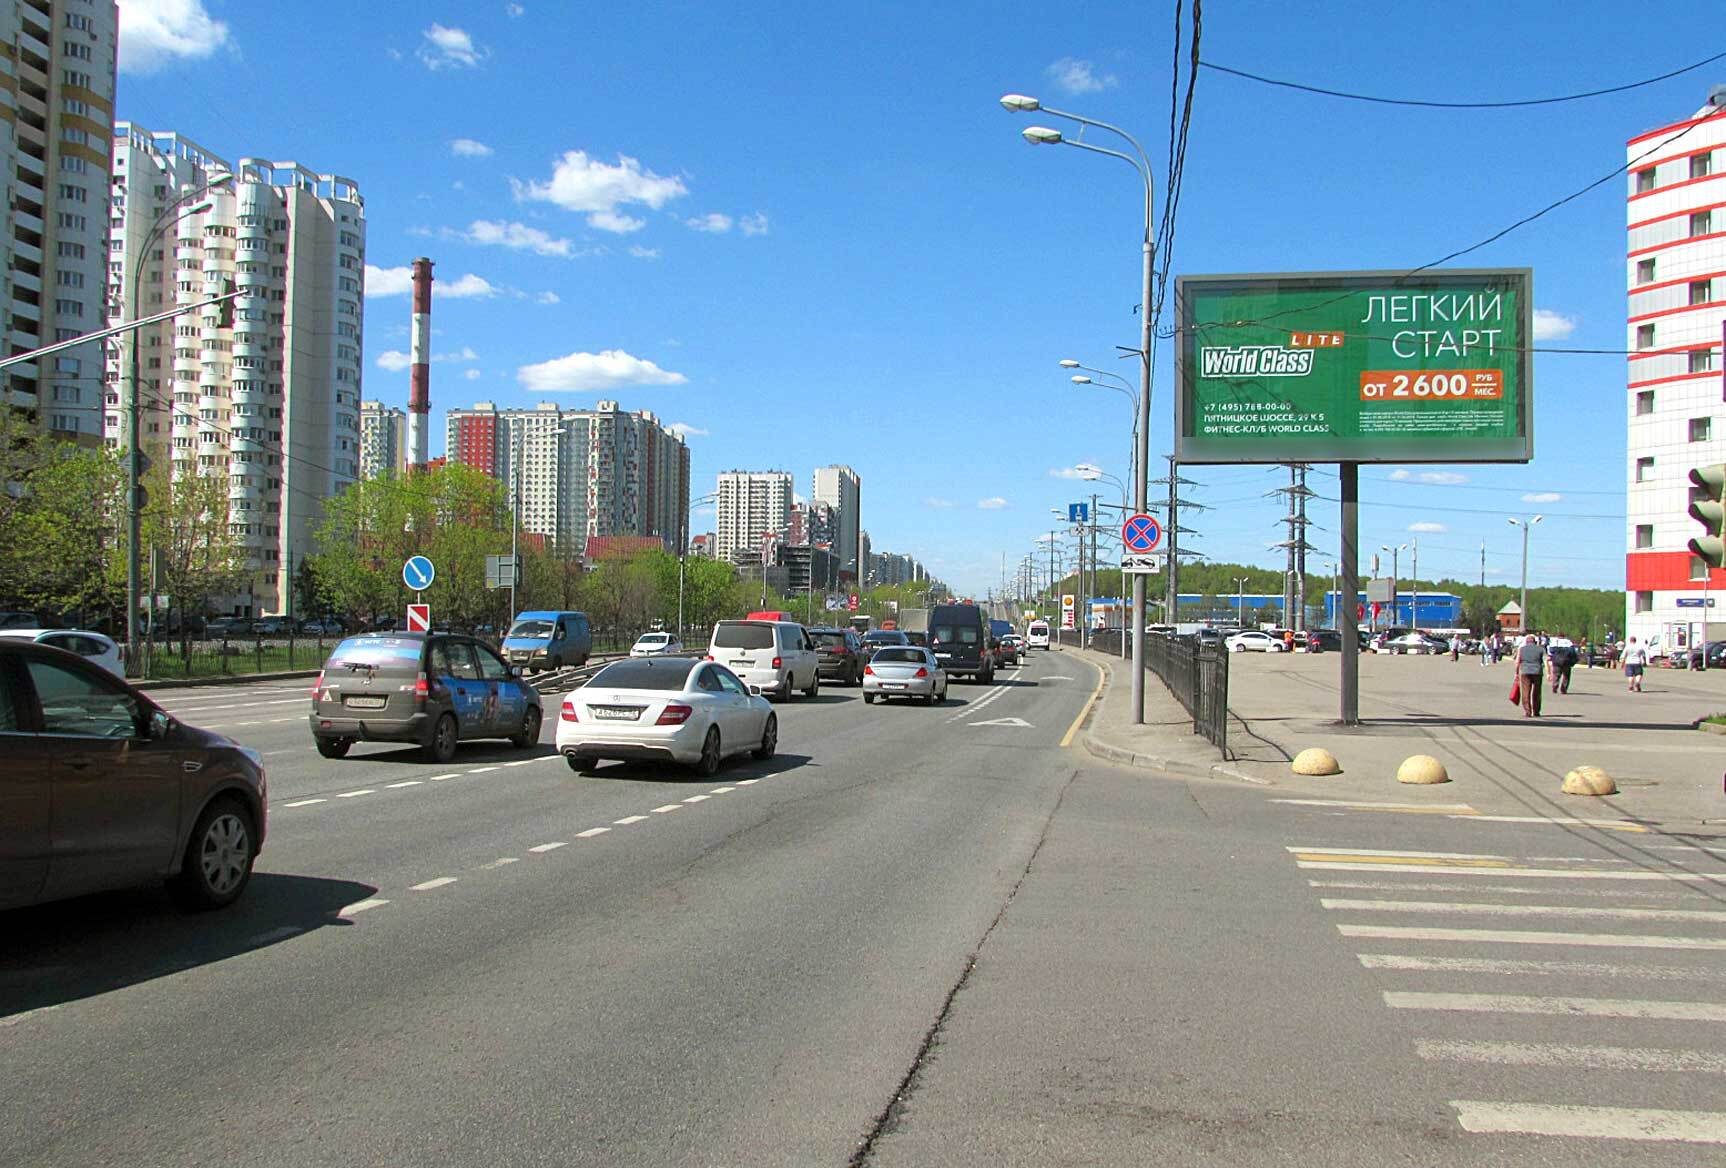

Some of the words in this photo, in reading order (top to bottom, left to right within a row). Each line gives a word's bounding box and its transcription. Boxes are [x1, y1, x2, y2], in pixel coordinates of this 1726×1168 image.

[1361, 288, 1501, 323] ЛЕГКИЙ
[1291, 334, 1341, 346] LITE
[1392, 330, 1502, 358] СТАРТ
[1204, 349, 1258, 374] World
[1259, 349, 1309, 373] Class
[1363, 383, 1387, 397] ОТ
[1218, 403, 1242, 412] (495)
[1204, 414, 1258, 423] ПЯТНИЦКОЕ
[1268, 424, 1301, 433] WORLD
[1302, 424, 1330, 433] CLASS
